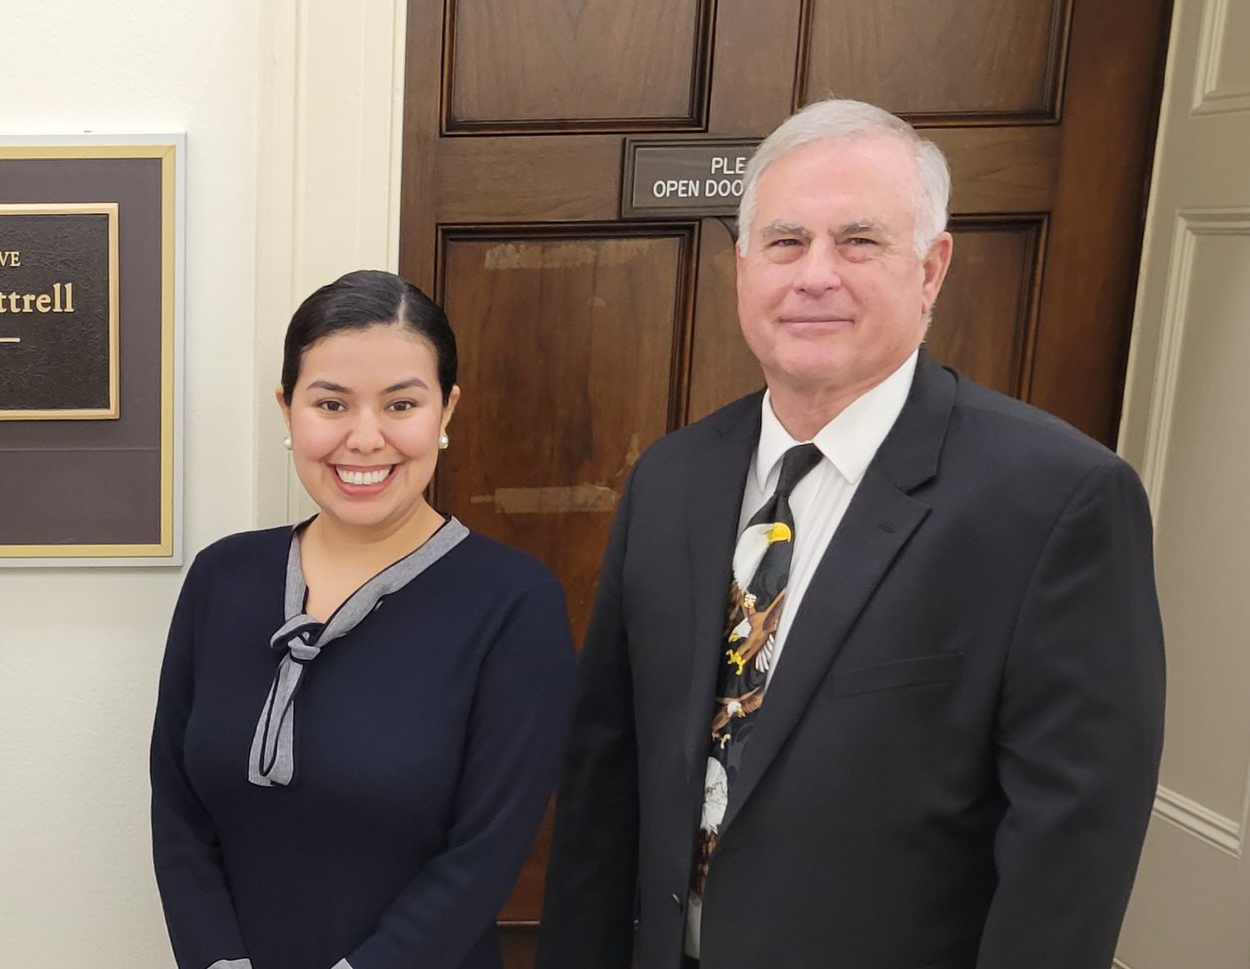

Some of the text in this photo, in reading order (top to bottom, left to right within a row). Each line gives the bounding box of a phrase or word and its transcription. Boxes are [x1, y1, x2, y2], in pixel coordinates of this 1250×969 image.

[711, 157, 747, 174] PLE
[653, 179, 744, 198] OPEN DOO
